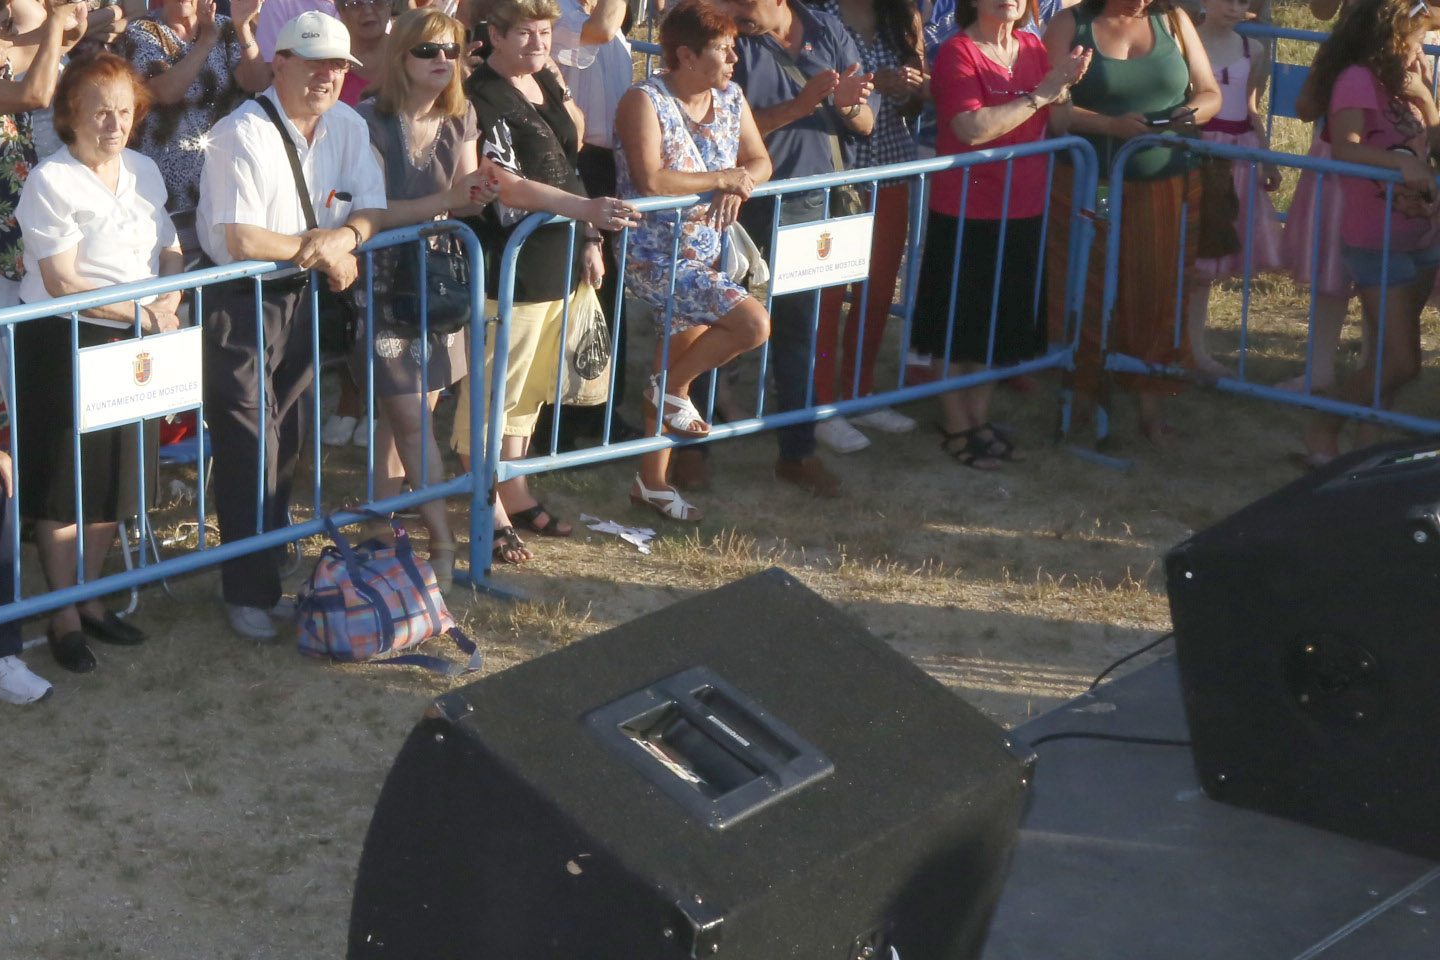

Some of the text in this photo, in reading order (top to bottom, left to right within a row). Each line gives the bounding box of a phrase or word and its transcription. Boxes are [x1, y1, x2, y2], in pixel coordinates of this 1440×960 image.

[777, 258, 866, 281] AYUNTAMIENTO DE MOSTOLES
[86, 381, 198, 413] AYUNTAMIENTO DE MOSTOLES
